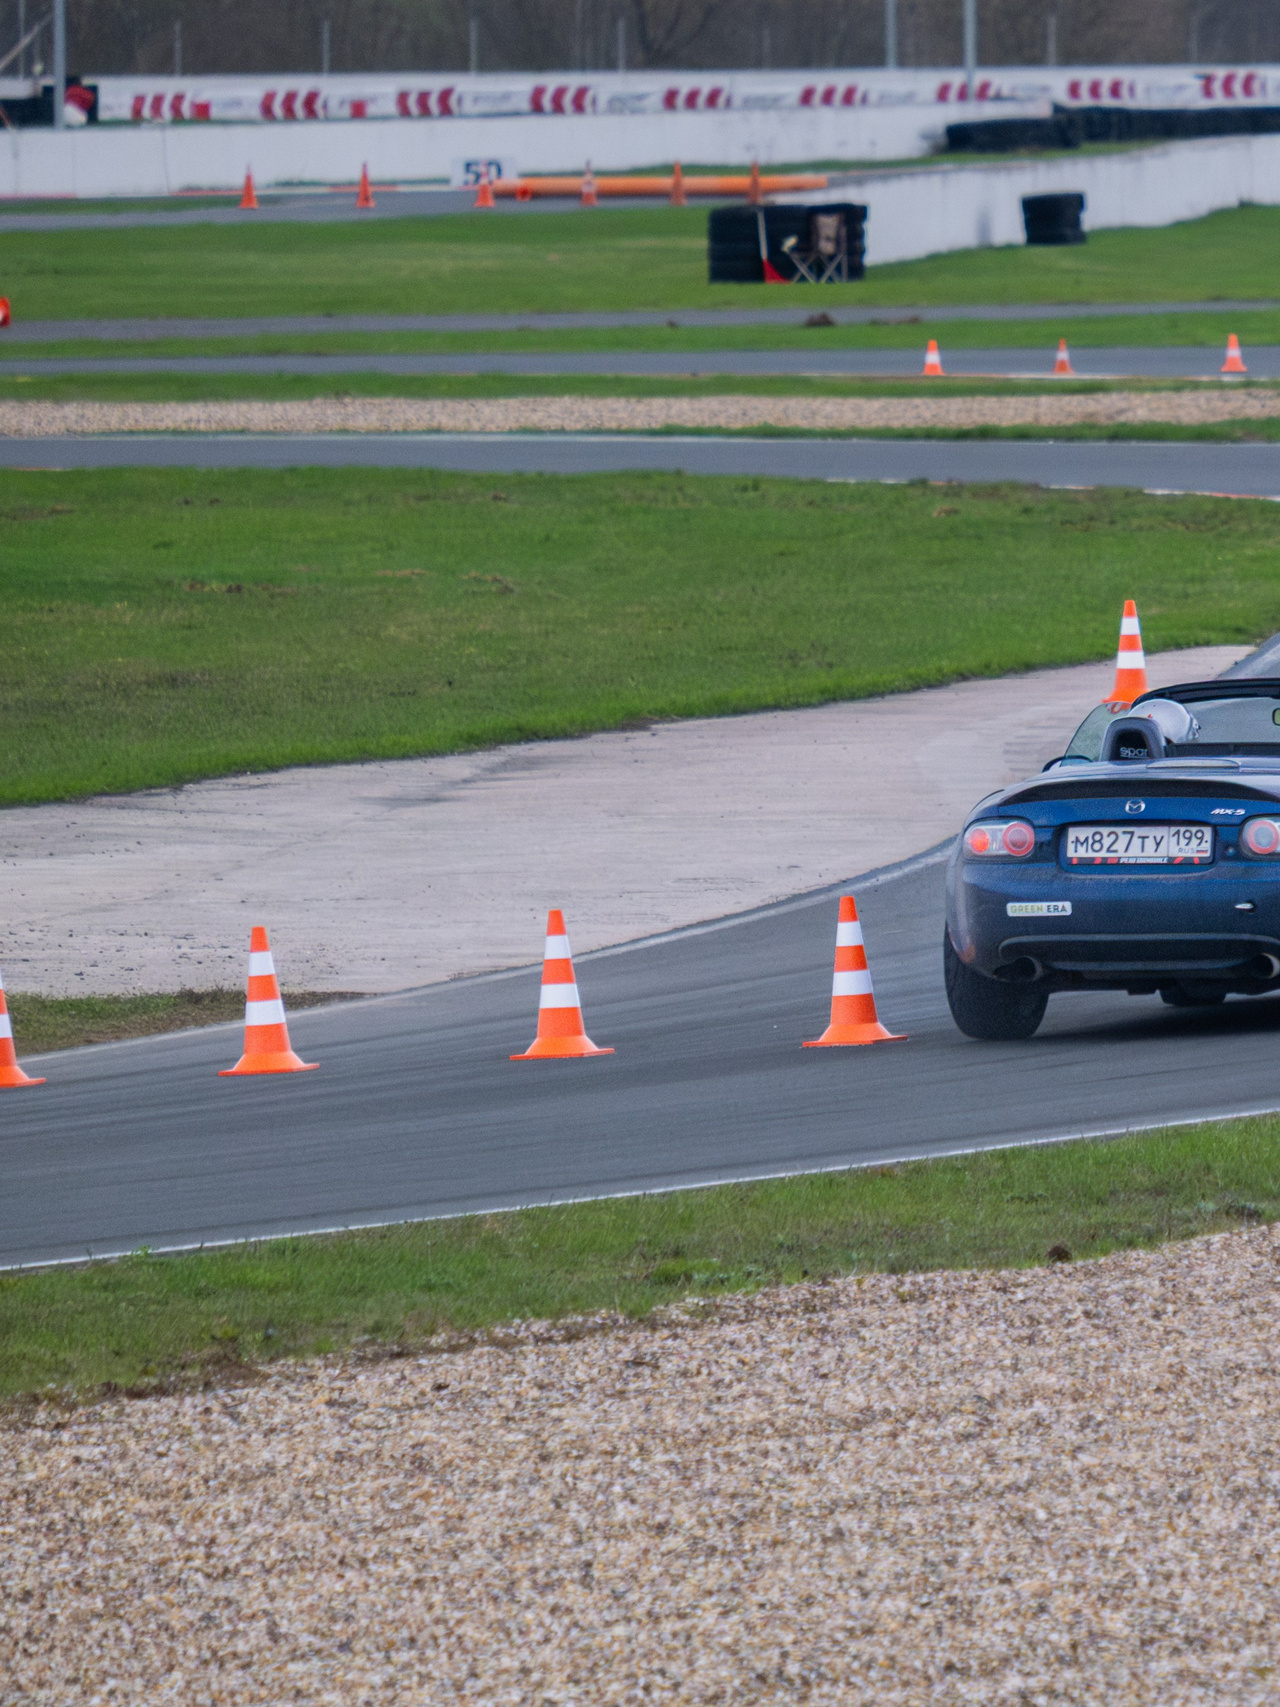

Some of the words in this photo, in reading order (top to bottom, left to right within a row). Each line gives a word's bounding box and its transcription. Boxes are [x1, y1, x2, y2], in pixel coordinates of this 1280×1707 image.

[464, 160, 502, 186] 50
[1171, 828, 1206, 847] 199
[1178, 847, 1195, 855] RUS
[1010, 904, 1044, 914] GREEN
[1046, 904, 1068, 913] ERA
